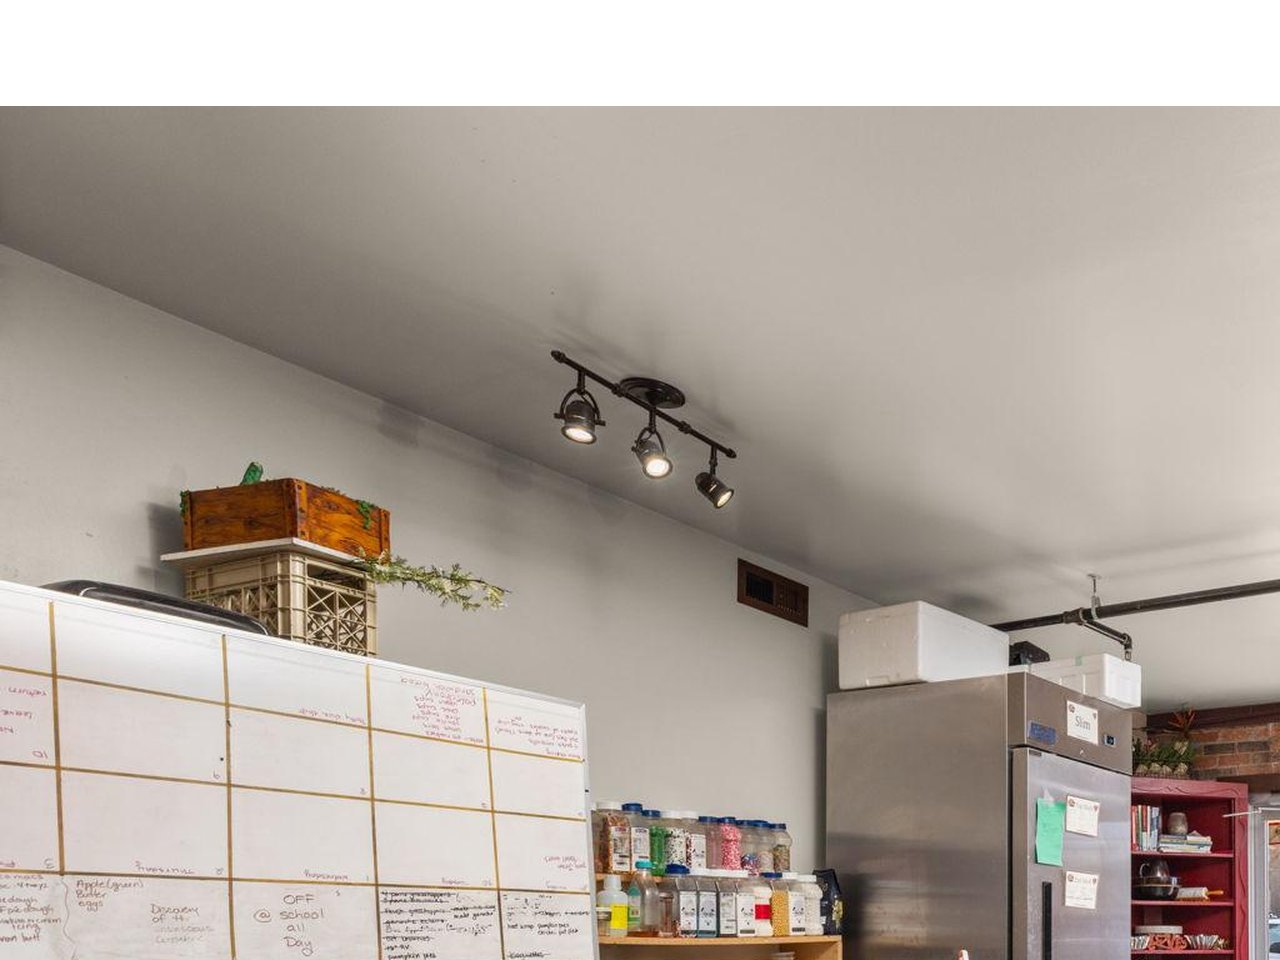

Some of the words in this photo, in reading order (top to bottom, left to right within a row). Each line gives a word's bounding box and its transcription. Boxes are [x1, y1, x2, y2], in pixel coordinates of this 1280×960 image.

[283, 893, 316, 905] OFF
[253, 909, 272, 923] @
[279, 907, 325, 920] school
[286, 922, 305, 933] all
[283, 936, 315, 957] Day
